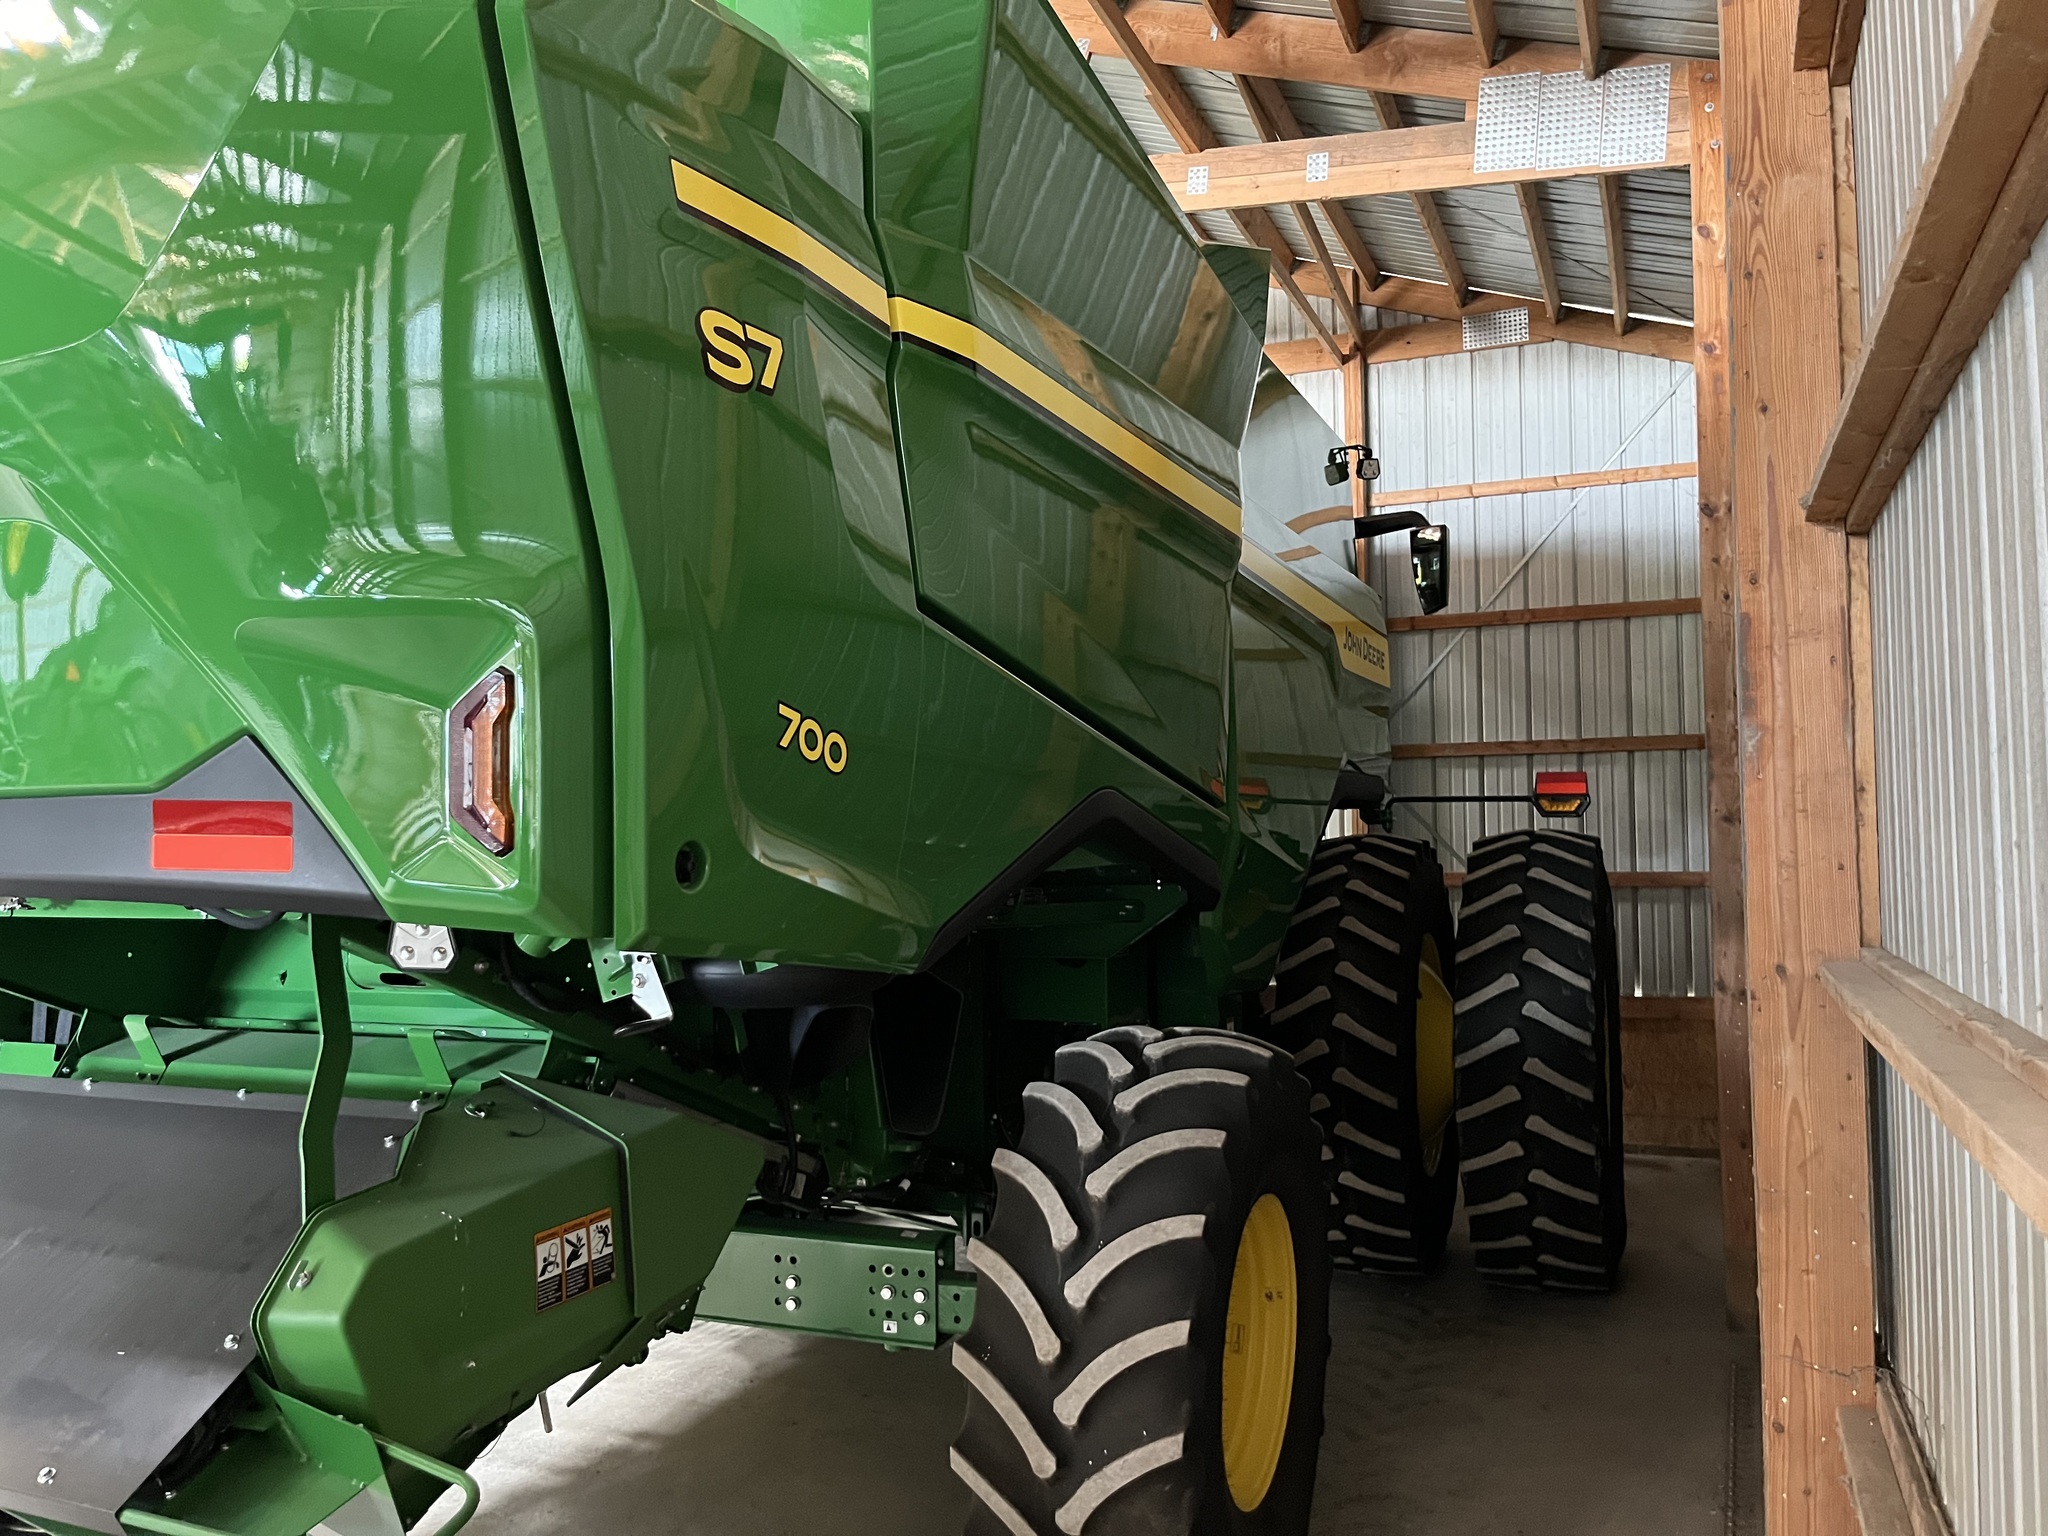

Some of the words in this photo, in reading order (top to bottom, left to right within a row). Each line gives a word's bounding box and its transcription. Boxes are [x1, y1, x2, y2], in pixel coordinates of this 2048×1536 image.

[696, 307, 784, 395] S7
[1343, 625, 1362, 658] JOHN
[1363, 636, 1385, 670] DEERE
[777, 701, 848, 775] 700
